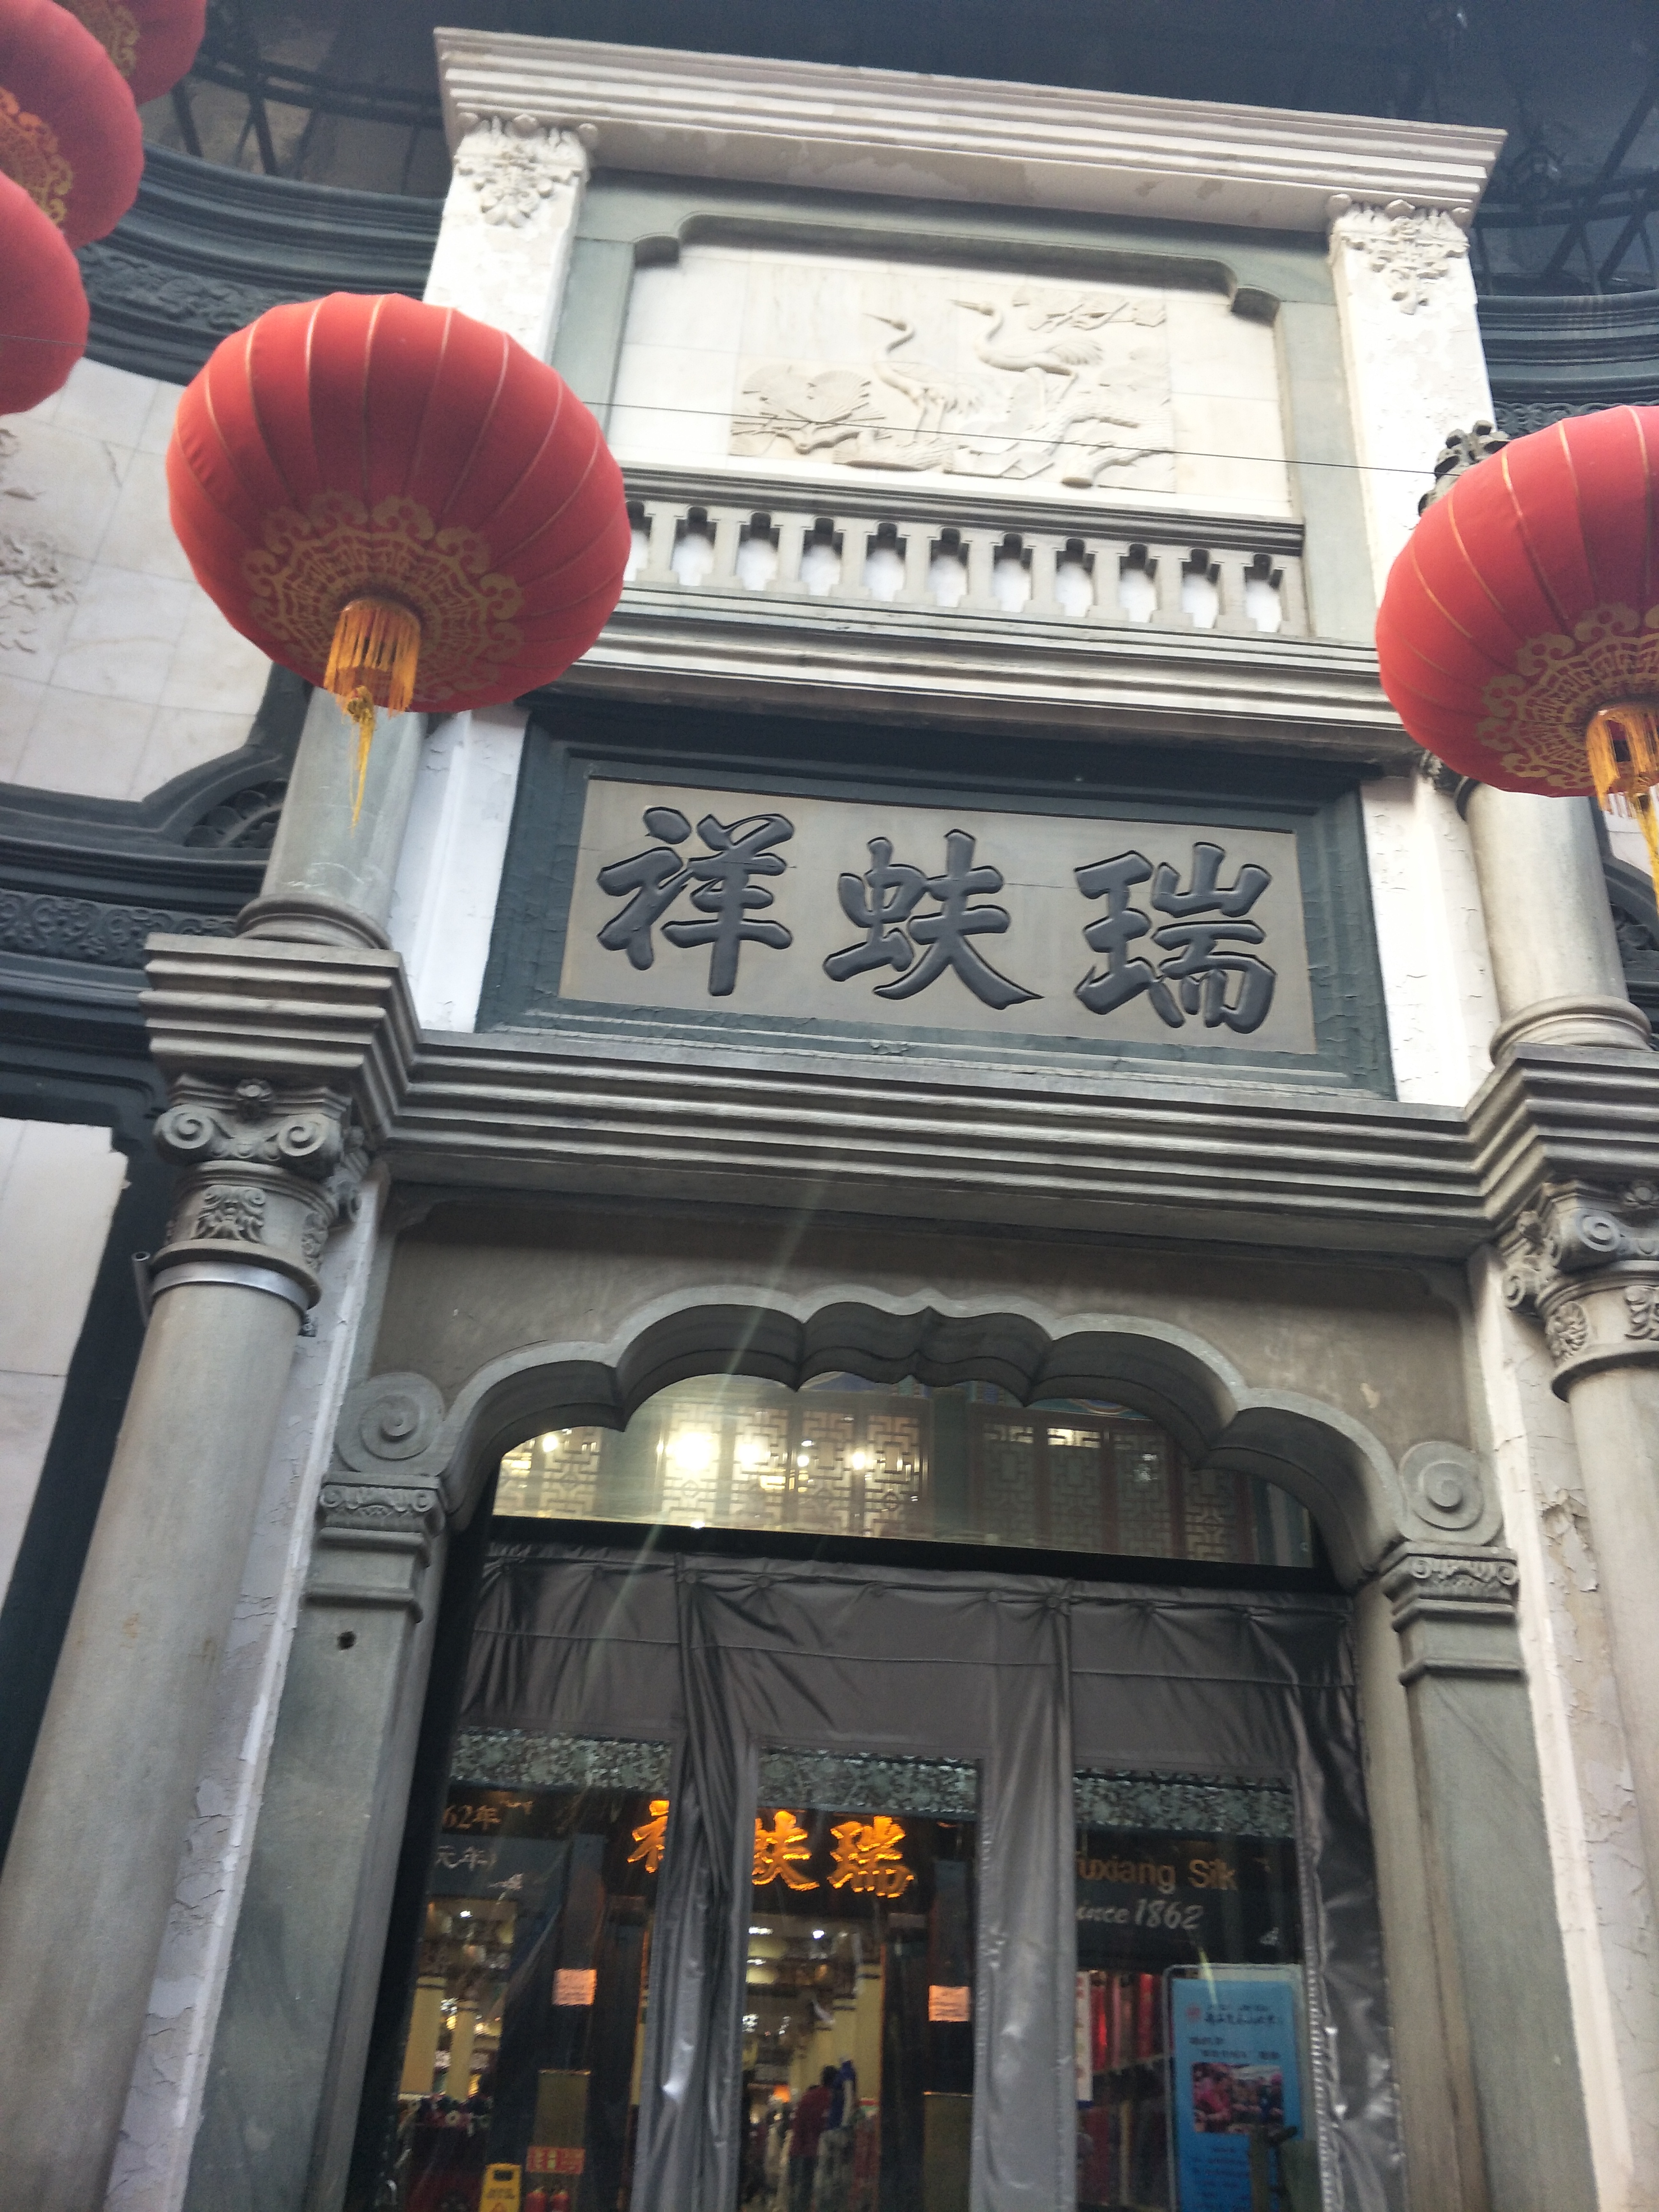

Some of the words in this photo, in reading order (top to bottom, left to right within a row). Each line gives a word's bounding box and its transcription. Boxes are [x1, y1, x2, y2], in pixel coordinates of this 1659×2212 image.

[596, 805, 1277, 1034] 瑞蚨祥
[1075, 1852, 1176, 1895] uxiang
[1188, 1858, 1238, 1891] Silk
[1075, 1899, 1130, 1924] ince
[1134, 1898, 1204, 1930] 1862
